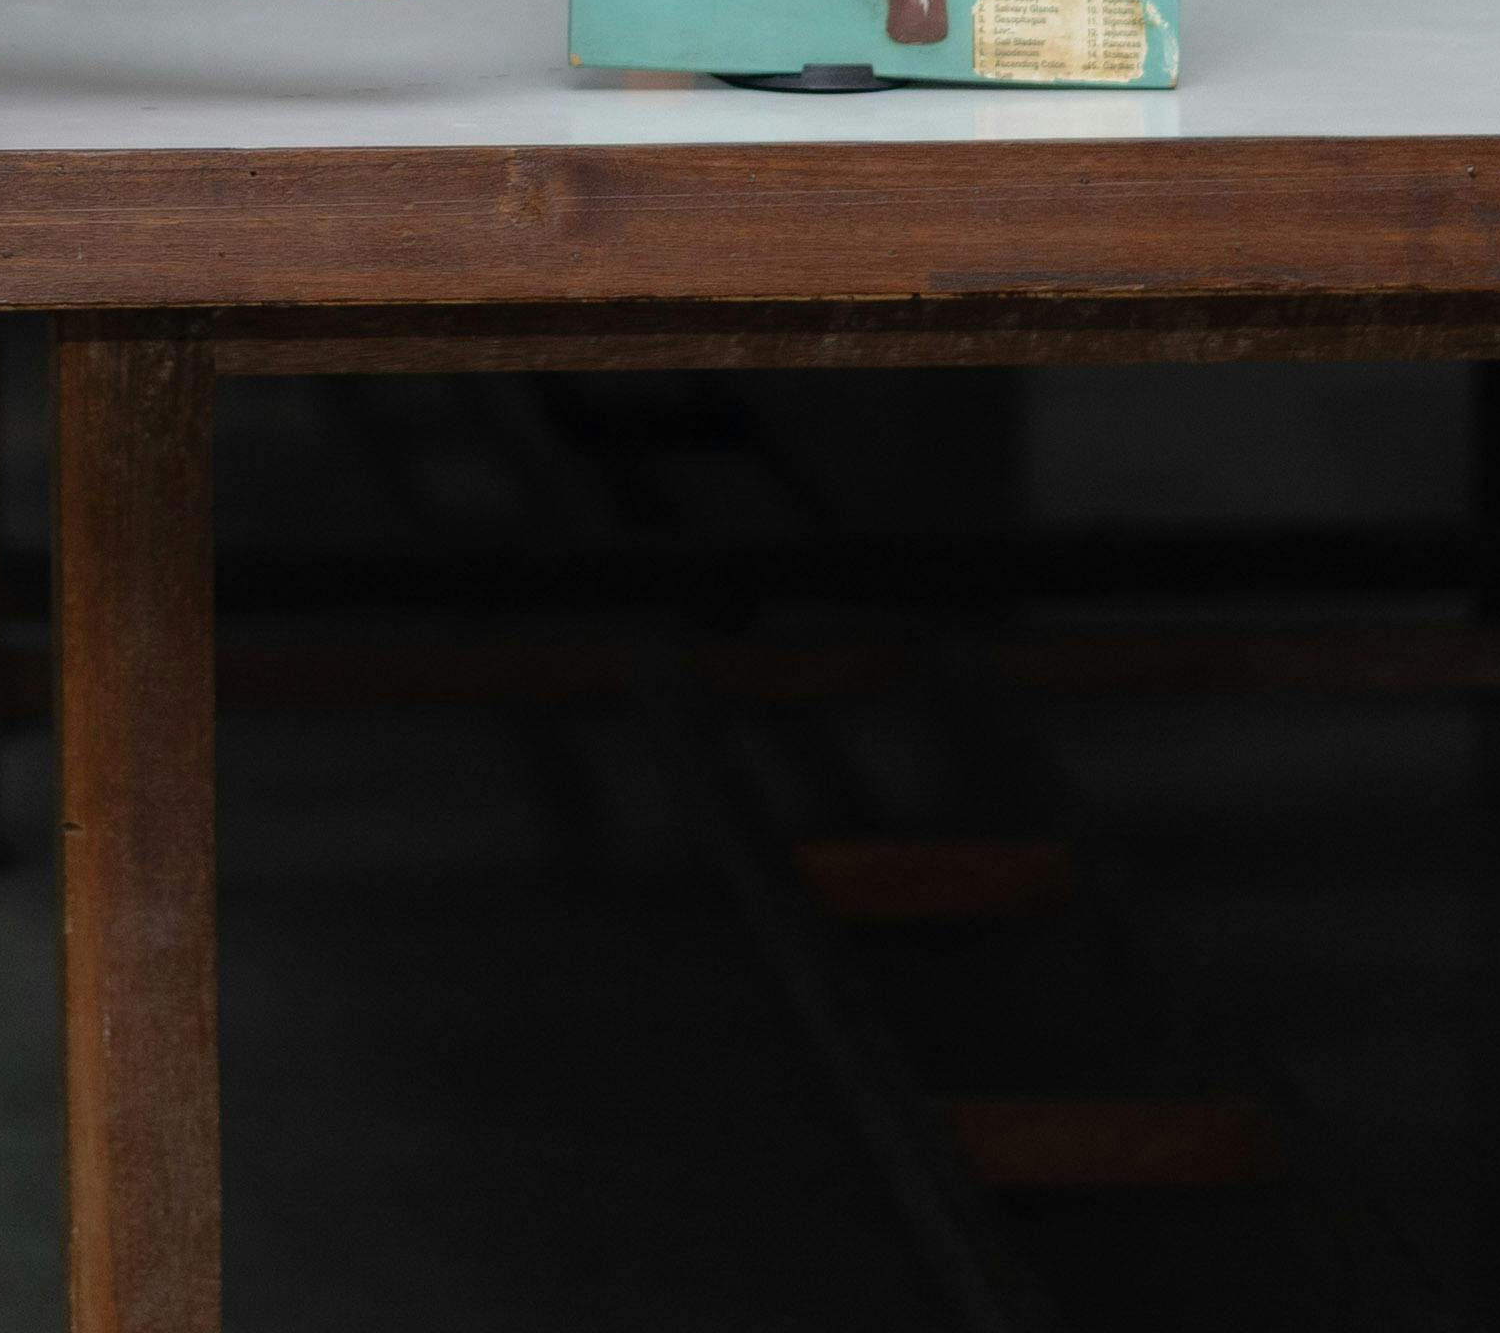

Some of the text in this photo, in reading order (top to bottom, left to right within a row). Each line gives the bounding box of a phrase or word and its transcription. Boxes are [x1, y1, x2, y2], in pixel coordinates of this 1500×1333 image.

[994, 4, 1027, 14] Salivary
[1030, 4, 1059, 13] Glands
[1102, 6, 1134, 14] Rectum
[994, 37, 1011, 46] Gall
[1014, 37, 1047, 46] Bladder
[1102, 39, 1141, 47] Pancreas
[1102, 50, 1139, 59] Stomach
[994, 60, 1039, 70] Ascending
[1041, 60, 1067, 68] Colon
